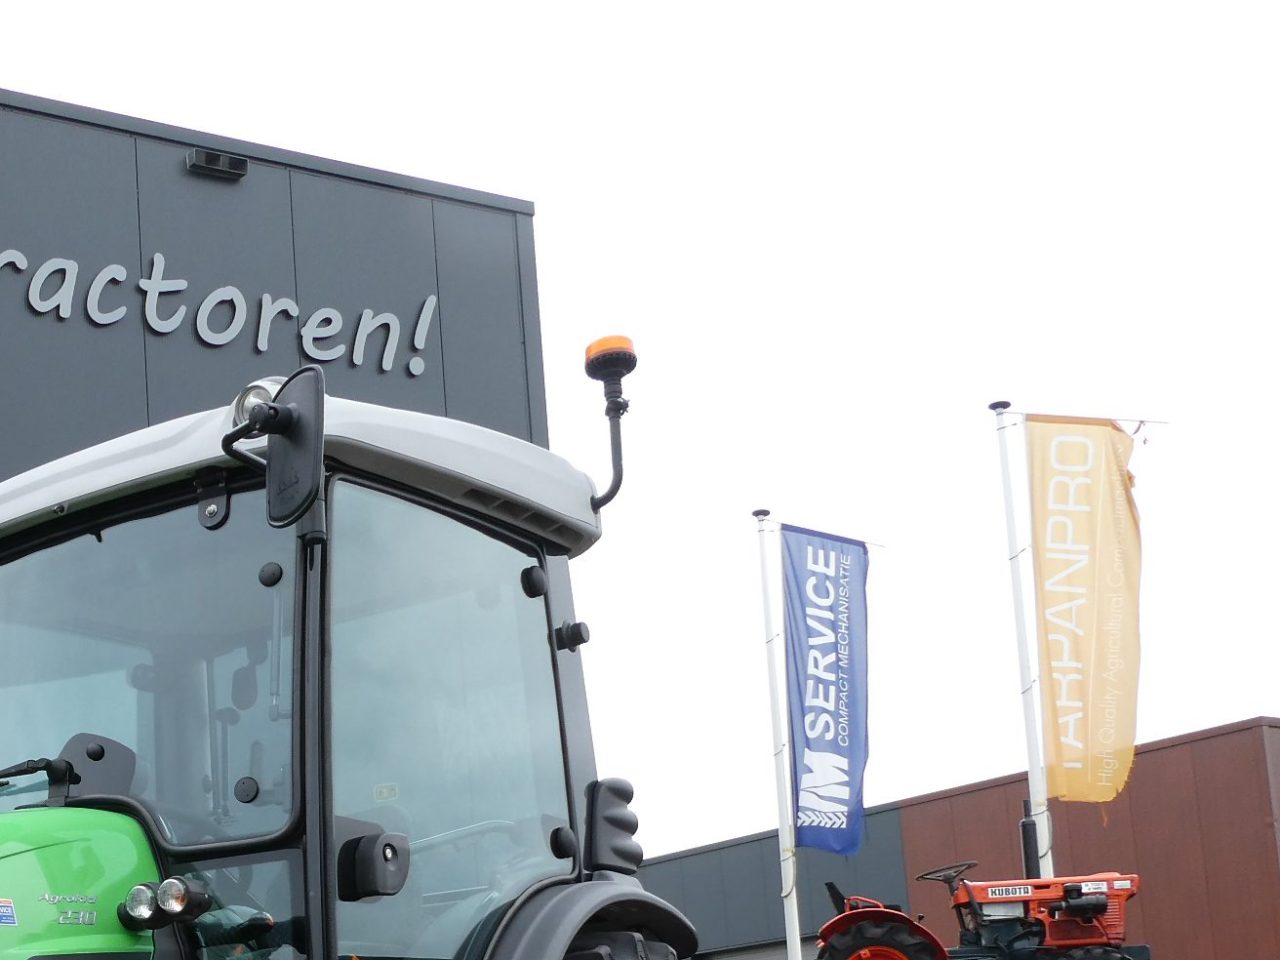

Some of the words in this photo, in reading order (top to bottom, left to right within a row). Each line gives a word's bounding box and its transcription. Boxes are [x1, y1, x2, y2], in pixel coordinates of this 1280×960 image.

[804, 545, 836, 740] SERVICE
[837, 554, 851, 668] MECHANISATIE
[1103, 592, 1125, 681] Agricultural
[838, 671, 849, 747] COMPACT
[1096, 686, 1120, 744] Quality
[1096, 753, 1119, 786] High
[990, 886, 1030, 897] KUBOTA
